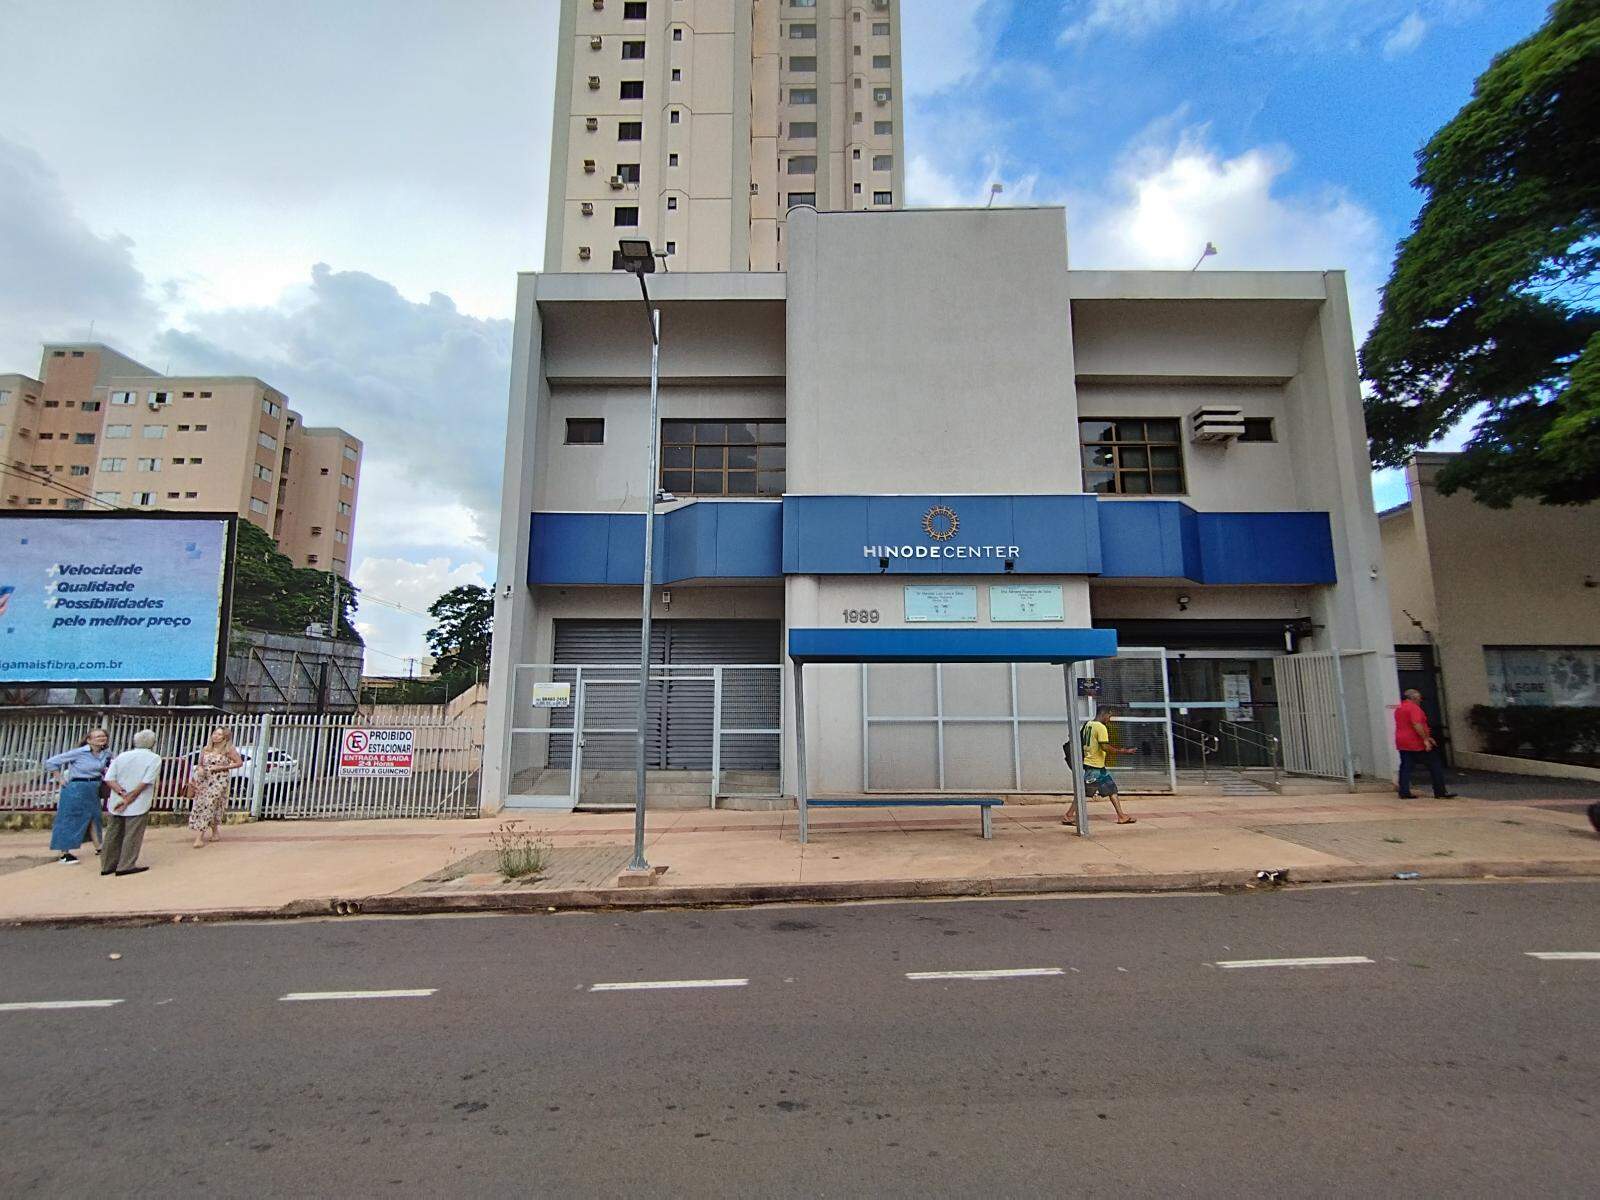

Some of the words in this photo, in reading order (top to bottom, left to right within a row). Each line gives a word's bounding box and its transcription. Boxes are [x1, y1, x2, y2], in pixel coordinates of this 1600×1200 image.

[52, 615, 87, 628] pelo
[89, 615, 144, 626] melhor
[146, 616, 192, 628] preço
[842, 608, 880, 624] 1989
[369, 731, 412, 740] PROIBIDO
[368, 743, 411, 753] ESTACIONAR
